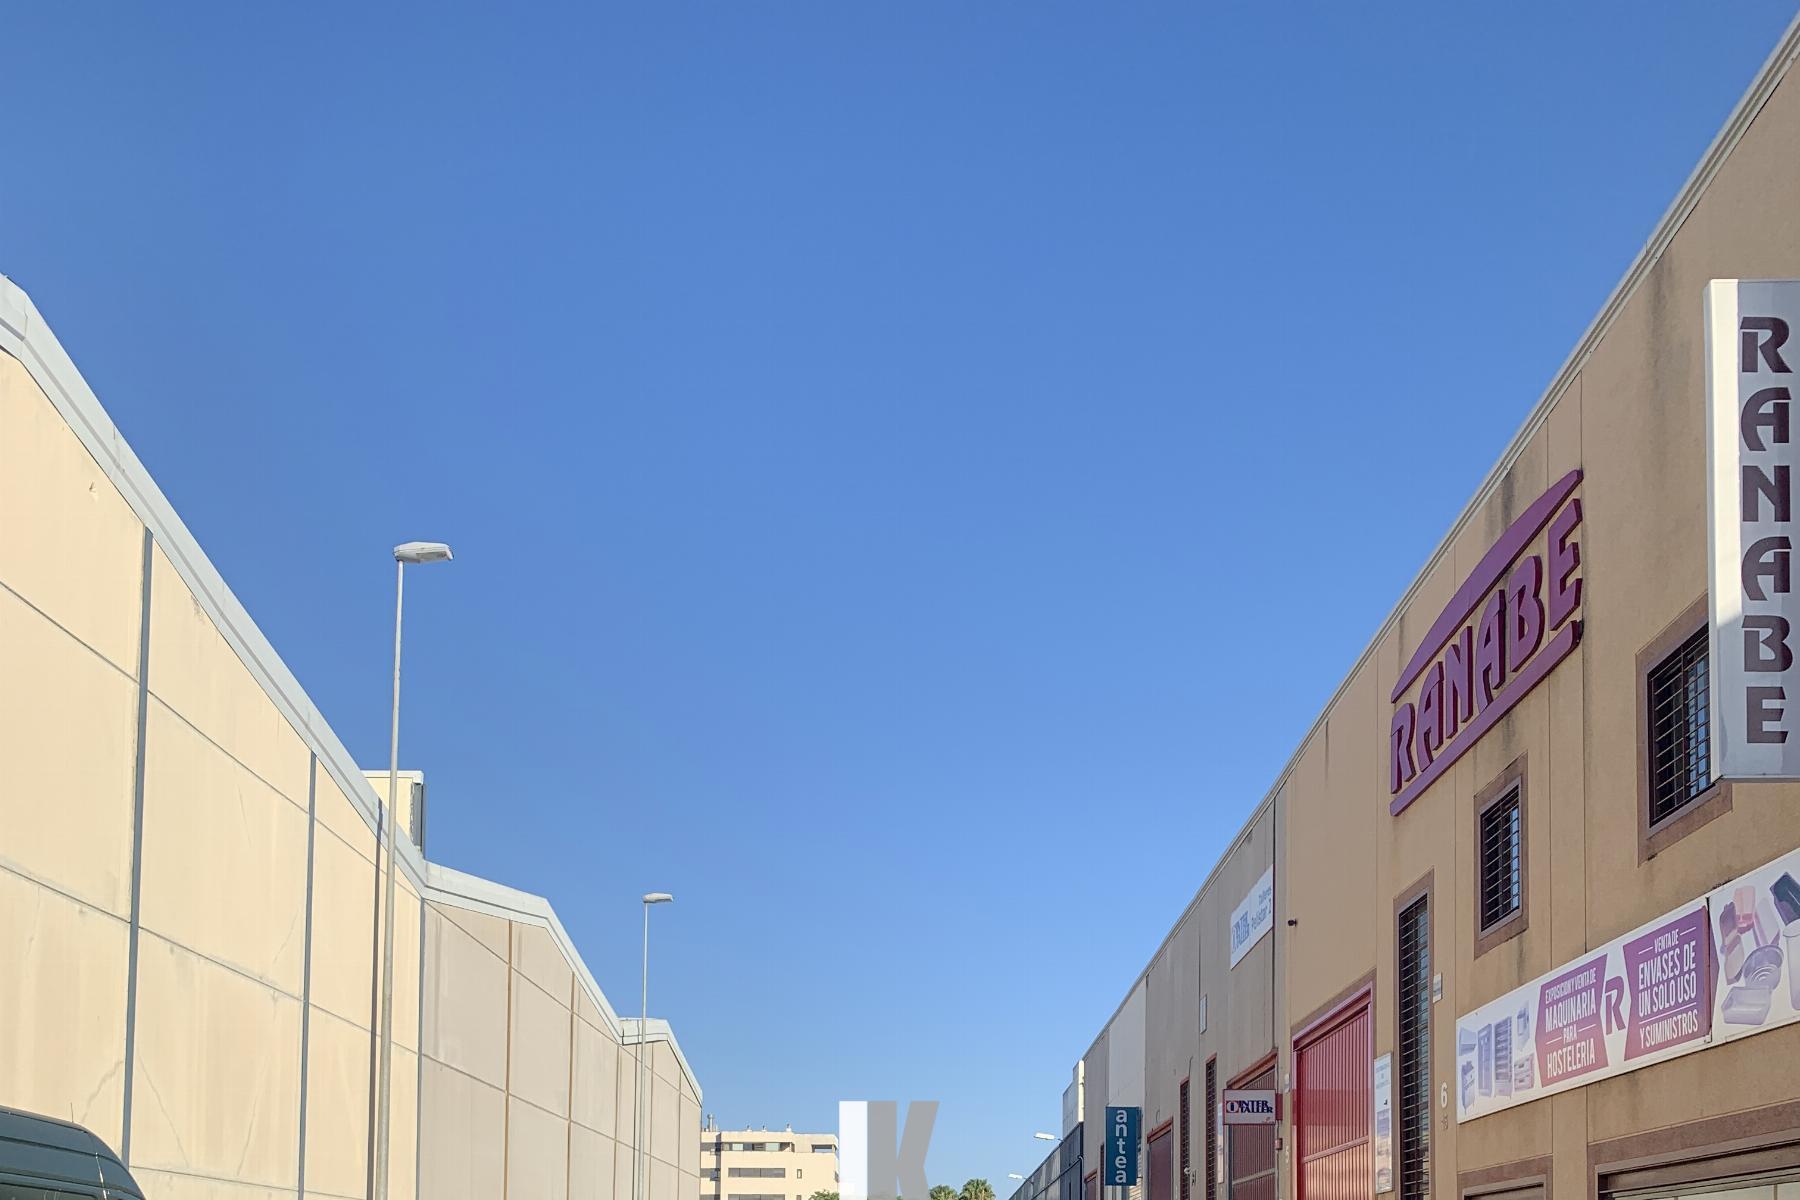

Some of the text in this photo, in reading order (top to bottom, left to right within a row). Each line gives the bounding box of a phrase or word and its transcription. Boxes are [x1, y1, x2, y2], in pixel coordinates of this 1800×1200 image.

[1739, 316, 1794, 744] RANABE
[1390, 497, 1582, 795] RANABE
[1638, 940, 1697, 990] ENVASES DE
[1654, 929, 1679, 954] VENTA DE
[1575, 970, 1590, 991] VENTA
[1590, 967, 1596, 985] DE
[1638, 971, 1697, 1018] UN SOLO USO
[1545, 987, 1597, 1034] MAQUINARIA
[1605, 975, 1626, 1036] R
[1639, 1009, 1698, 1049] Y SUMINISTROS
[1563, 1024, 1578, 1045] PARA
[1547, 1038, 1596, 1079] HOSTELERIA
[1440, 1082, 1448, 1109] 6
[1115, 1109, 1128, 1184] antea
